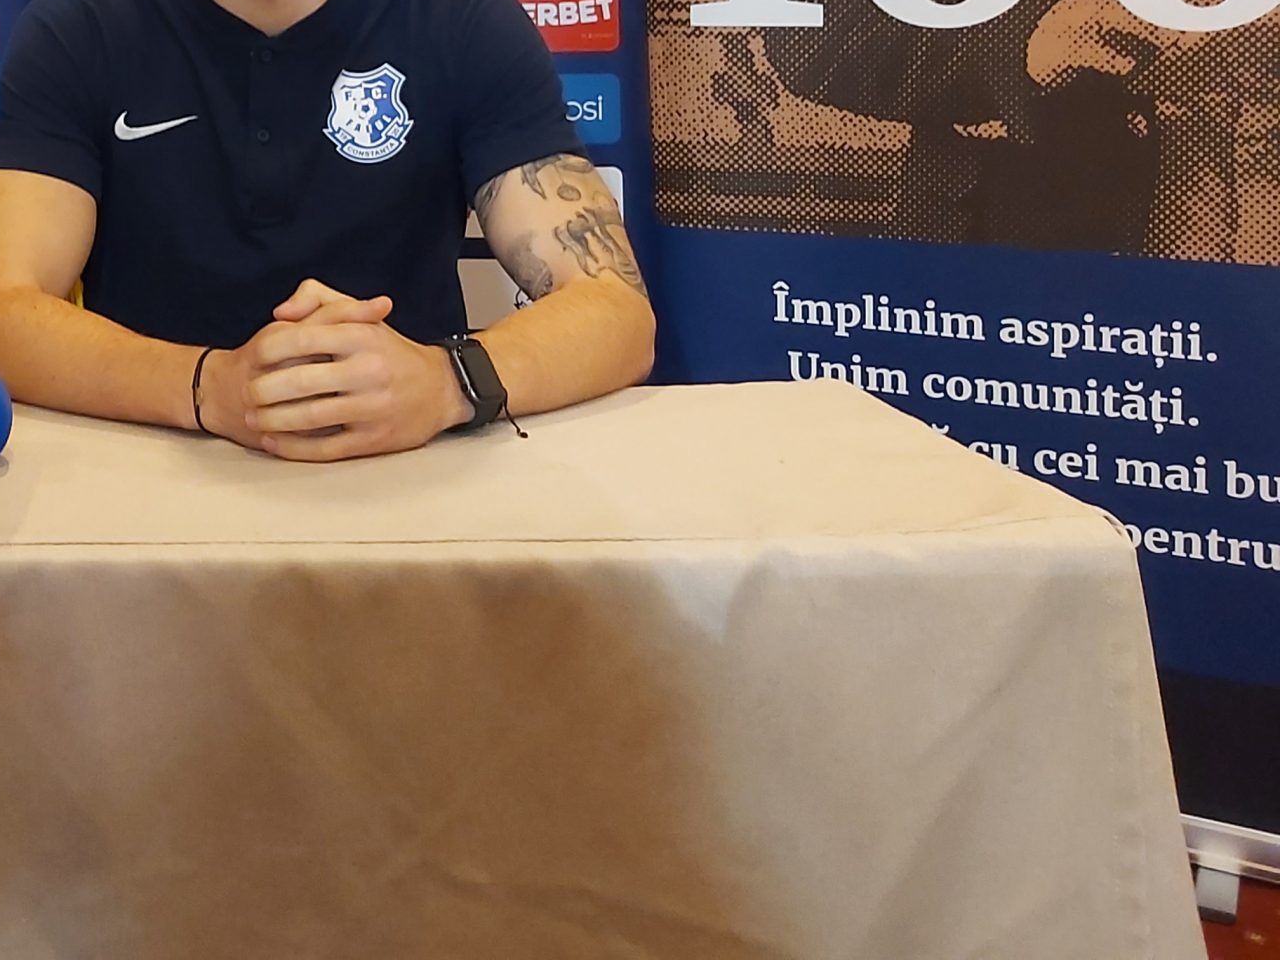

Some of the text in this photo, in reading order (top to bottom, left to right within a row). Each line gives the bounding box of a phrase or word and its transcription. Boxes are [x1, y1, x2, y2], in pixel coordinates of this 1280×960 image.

[772, 281, 986, 339] Împlinim
[1033, 444, 1100, 481] cei
[1115, 455, 1210, 495] mai
[1223, 460, 1280, 503] bu
